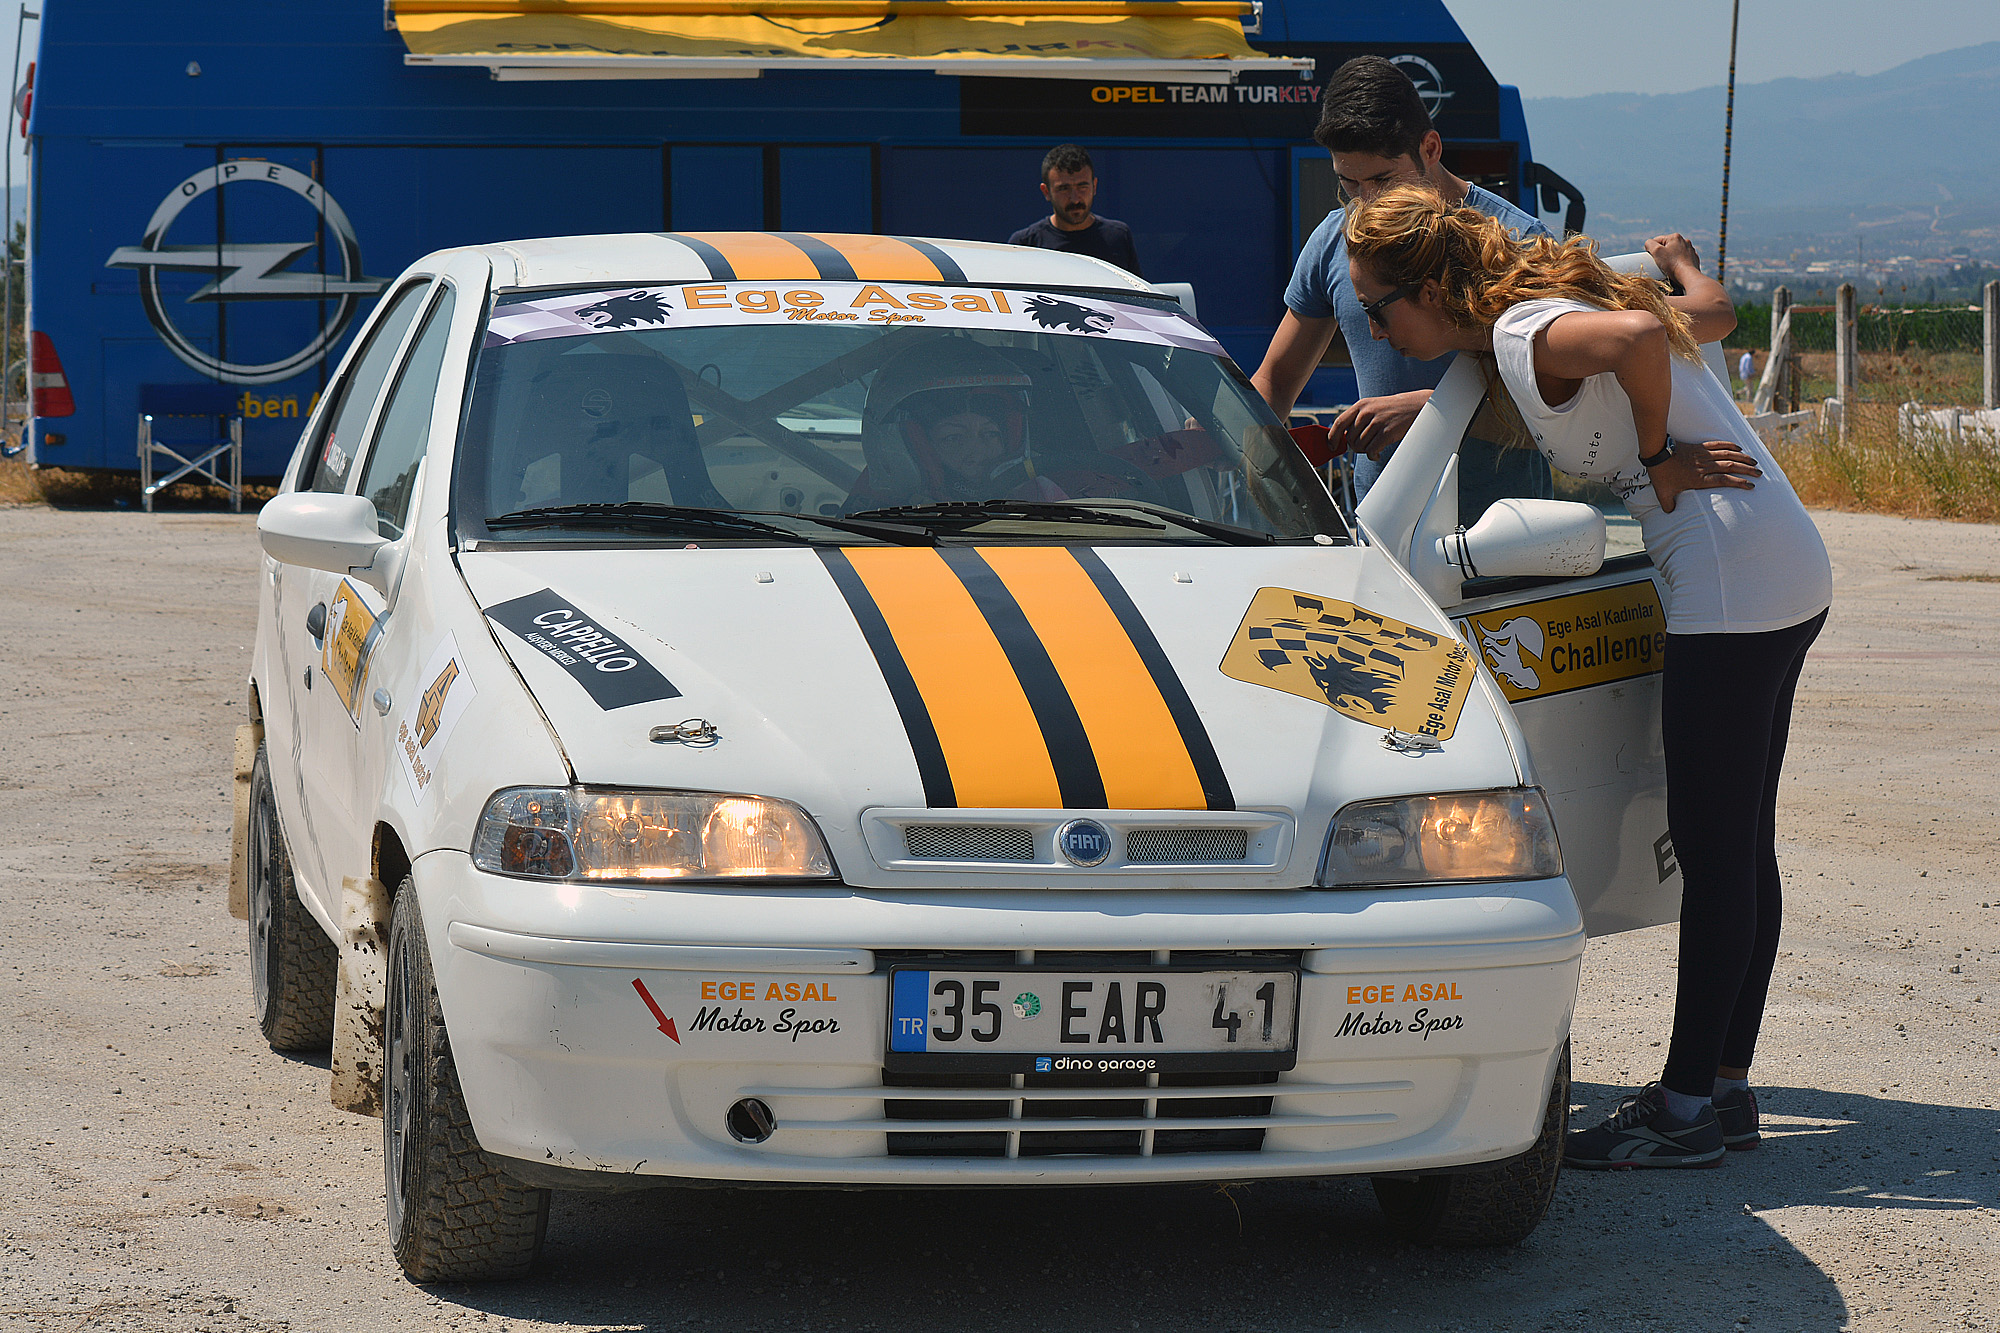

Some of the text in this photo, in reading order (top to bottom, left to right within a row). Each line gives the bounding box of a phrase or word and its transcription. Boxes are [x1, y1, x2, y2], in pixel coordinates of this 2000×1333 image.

[1091, 86, 1322, 103] OPEL TEAM TURKEY
[182, 165, 317, 199] OPEL
[681, 284, 1013, 314] Ege Asal
[783, 307, 926, 325] Motor Spor
[1582, 431, 1602, 467] late
[1547, 602, 1654, 639] Ege Asal Kadınlar
[532, 609, 638, 673] CAPPELLO
[1550, 631, 1665, 674] Challenge
[1435, 661, 1462, 688] Motor
[1427, 686, 1453, 712] Asal
[1418, 713, 1446, 736] Ege
[1069, 834, 1101, 851] FIAT
[701, 981, 837, 1001] EGE ASAL
[1346, 982, 1463, 1004] EGE ASAL
[688, 1006, 841, 1042] Motor Spor
[932, 980, 1002, 1042] 35
[1060, 981, 1166, 1043] EAR
[1333, 1007, 1464, 1041] Motor Spor
[899, 1017, 924, 1035] TR
[1055, 1056, 1157, 1072] dino garage
